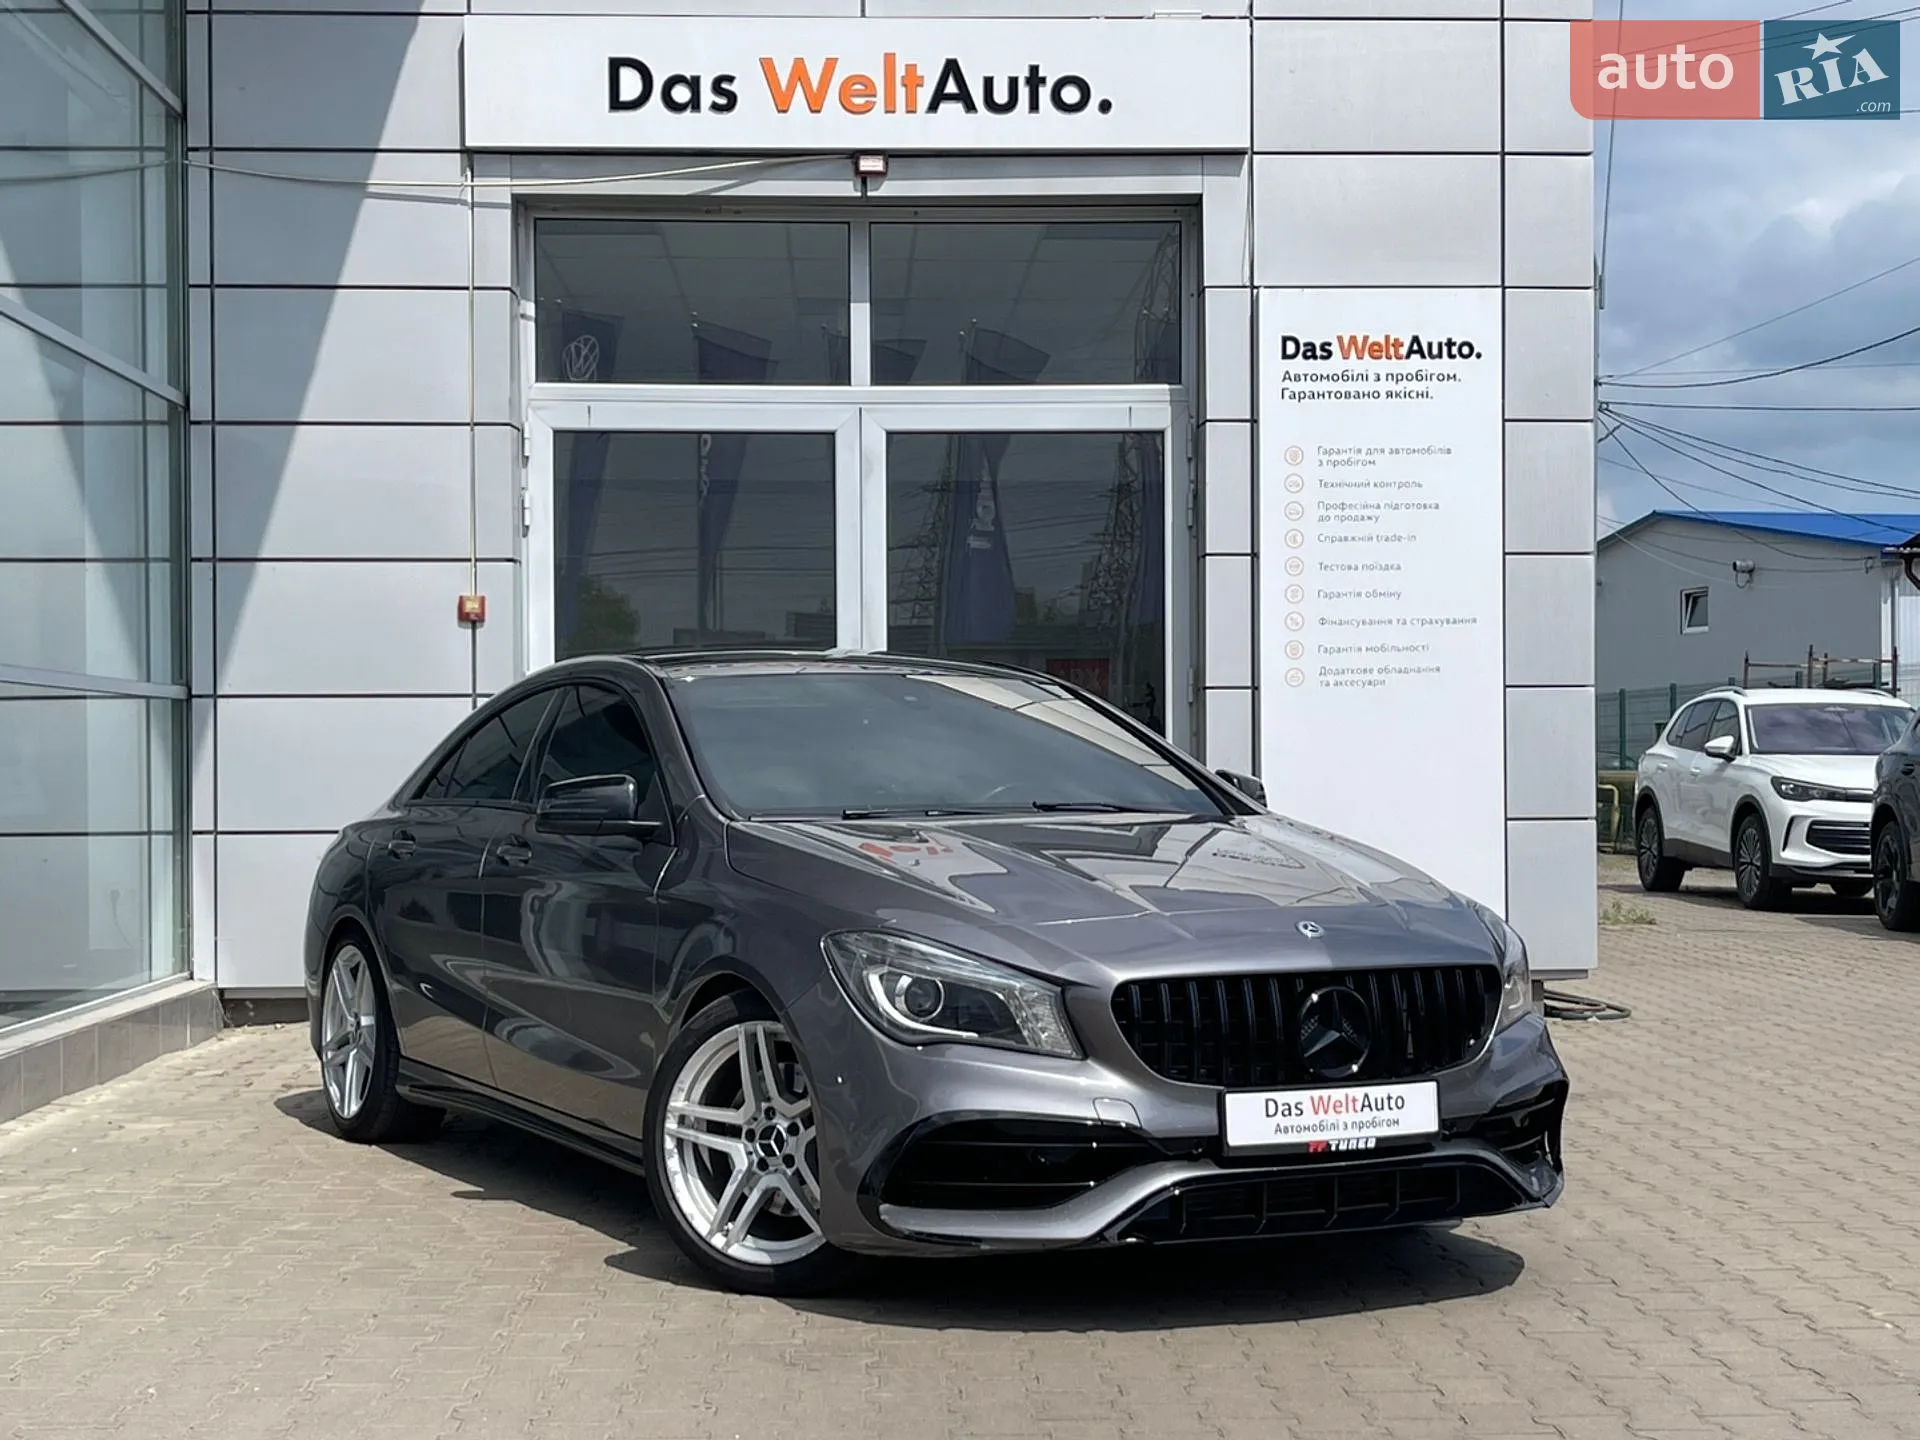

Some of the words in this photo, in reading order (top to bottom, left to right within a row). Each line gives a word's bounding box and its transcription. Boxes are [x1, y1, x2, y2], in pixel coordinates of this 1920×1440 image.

[607, 55, 739, 116] Das
[759, 52, 1114, 116] WeltAuto.
[1281, 335, 1333, 360] Das
[1337, 334, 1482, 360] WeltAuto.
[1281, 369, 1369, 383] Автомобілі
[1373, 372, 1381, 382] з
[1386, 369, 1462, 387] пробігом.
[1281, 387, 1380, 403] Гарантовано
[1385, 387, 1434, 400] якісні.
[1317, 446, 1362, 458] Гарантія
[1365, 447, 1385, 456] для
[1388, 444, 1452, 455] автомобілів
[1317, 459, 1324, 467] з
[1327, 457, 1376, 469] пробігом
[1319, 479, 1371, 489] Технічний
[1374, 479, 1423, 490] контроль
[1317, 501, 1381, 512] Професійна
[1384, 501, 1440, 513] підготовка
[1317, 514, 1330, 523] до
[1334, 514, 1380, 523] продажу
[1317, 533, 1373, 544] Справжній
[1376, 532, 1416, 542] trade-in
[1319, 562, 1358, 572] Тестова
[1362, 561, 1402, 572] поїздка
[1317, 590, 1362, 600] Гарантія
[1365, 589, 1402, 600] обміну
[1319, 617, 1393, 628] Фінансування
[1397, 617, 1407, 625] та
[1410, 616, 1477, 628] страхування
[1317, 645, 1362, 655] Гарантія
[1366, 643, 1430, 653] мобільності
[1319, 666, 1374, 676] Додаткове
[1320, 679, 1330, 688] та
[1333, 678, 1385, 688] аксесуари
[1265, 1098, 1304, 1118] Das
[1310, 1091, 1405, 1116] WeltAuto
[1274, 1120, 1340, 1135] Автомобілі
[1343, 1122, 1349, 1131] з
[1351, 1117, 1400, 1133] пробігом
